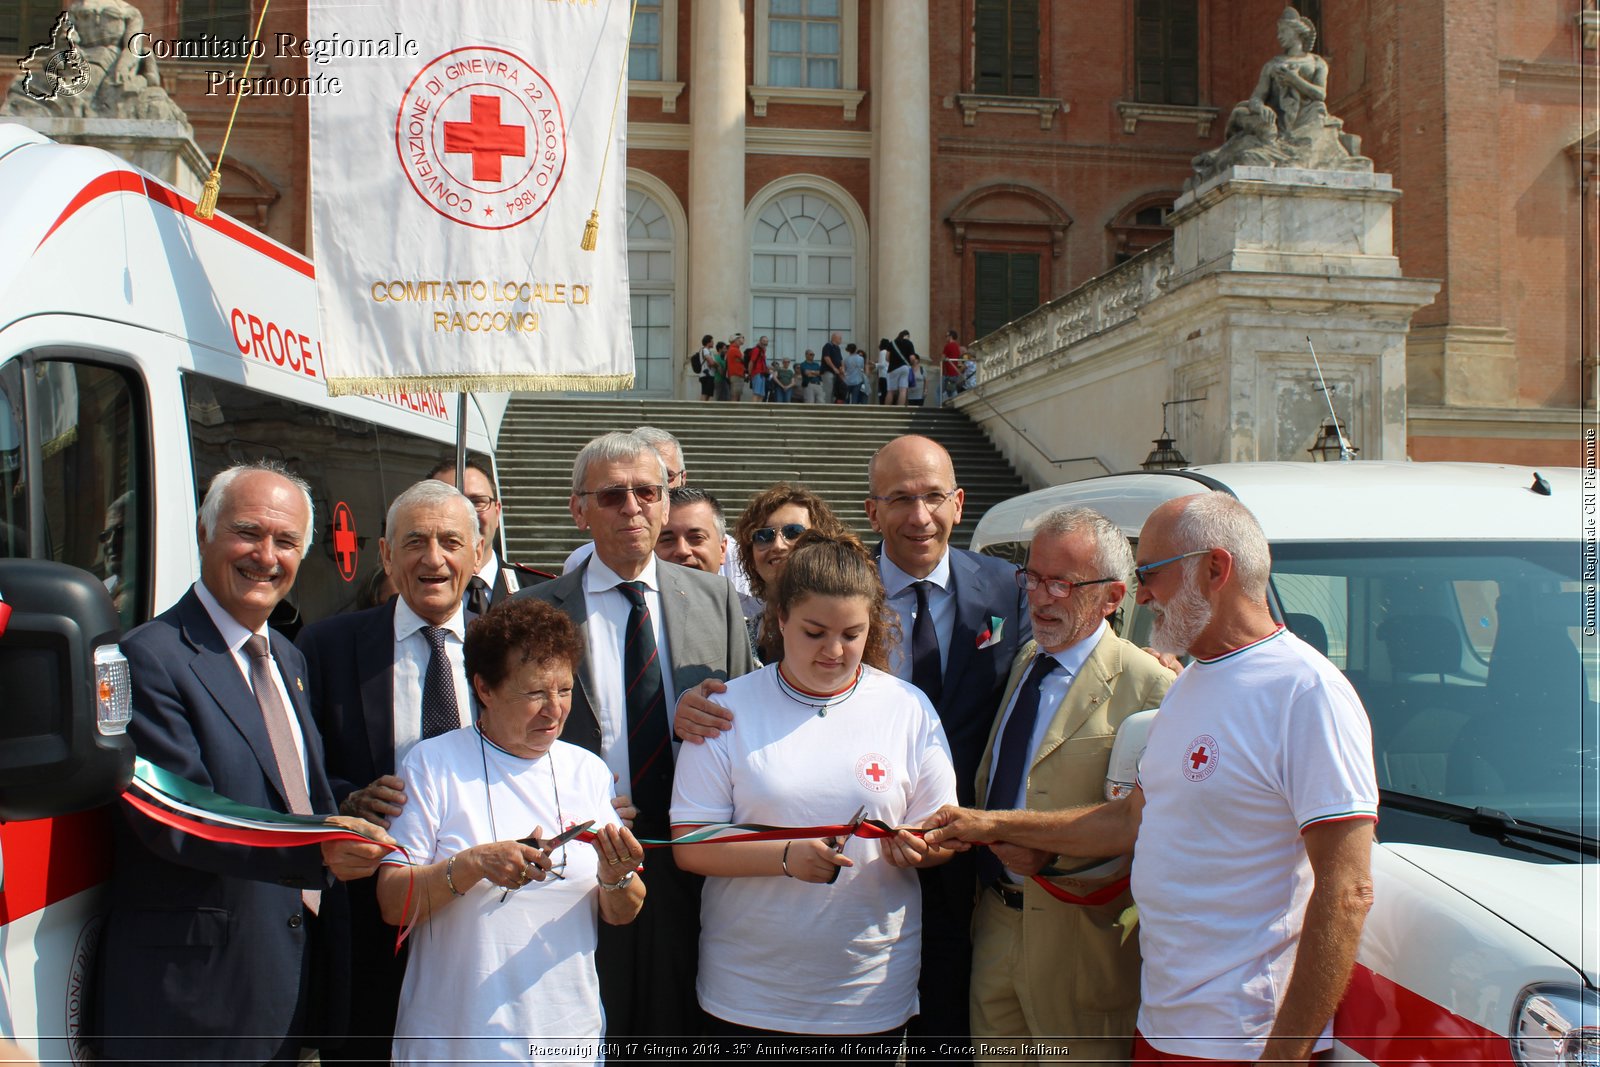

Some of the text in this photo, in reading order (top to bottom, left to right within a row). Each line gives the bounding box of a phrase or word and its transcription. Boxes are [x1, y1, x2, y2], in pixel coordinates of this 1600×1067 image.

[409, 59, 557, 216] CONVENZIONE DI GINEVRA 22 AGOSTO 1864
[371, 280, 590, 305] COMITATO LOCALE DI
[231, 308, 316, 377] CROCE
